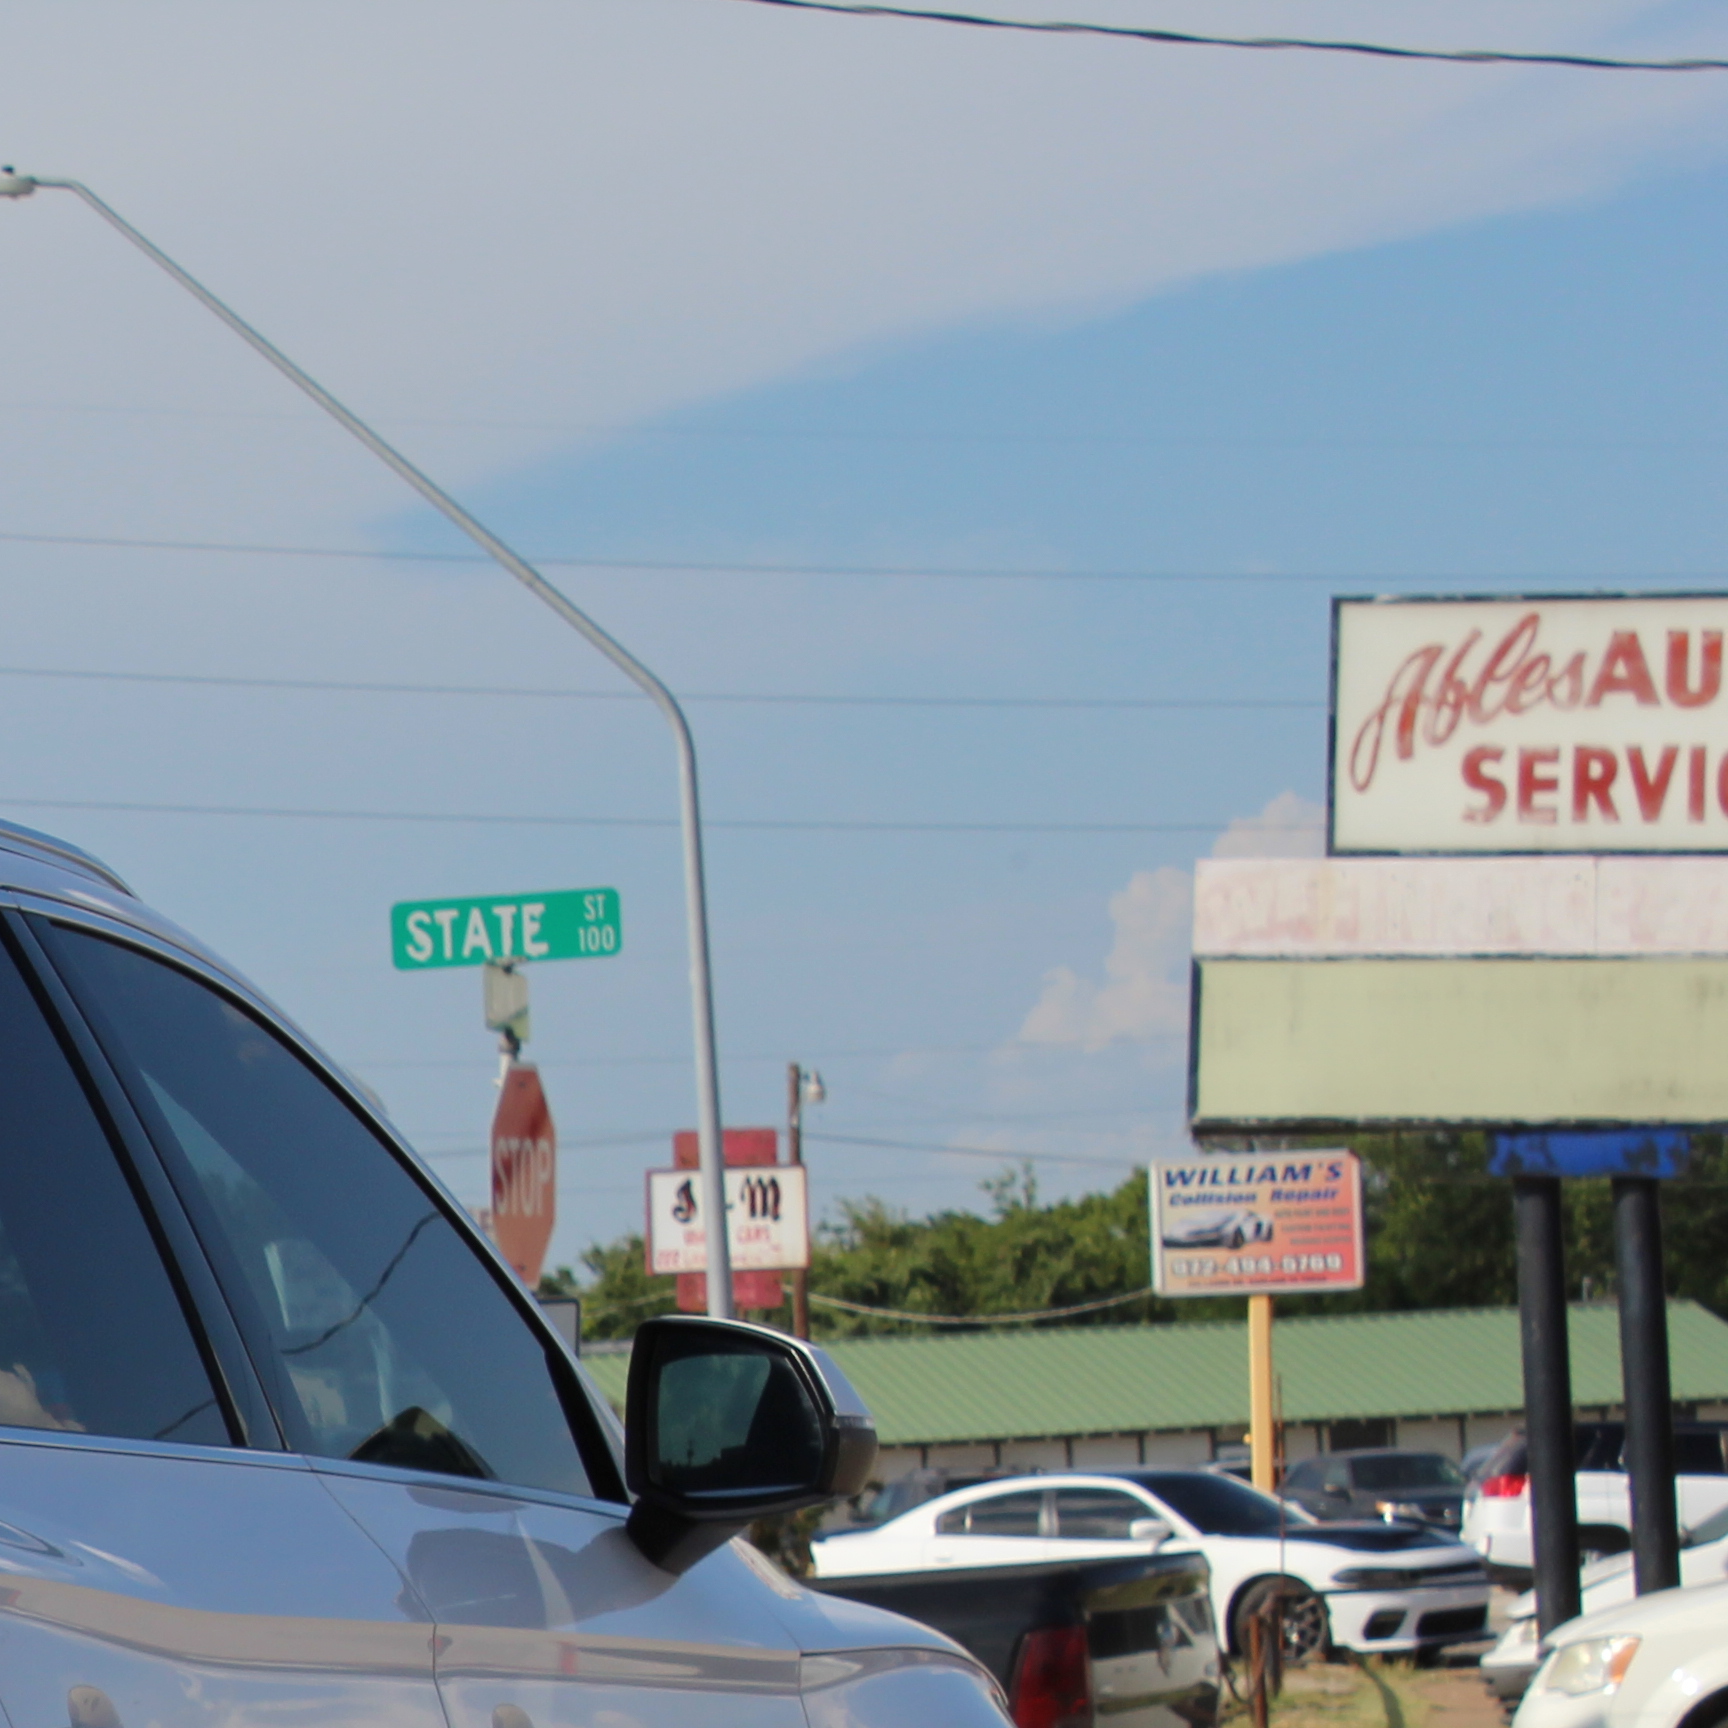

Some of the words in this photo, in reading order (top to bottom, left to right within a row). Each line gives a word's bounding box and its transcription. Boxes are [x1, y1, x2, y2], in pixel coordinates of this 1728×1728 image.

[1584, 629, 1725, 709] AU
[1461, 744, 1728, 824] SERVI
[405, 903, 550, 963] STATE
[584, 894, 606, 921] ST
[579, 925, 615, 952] 100
[495, 1136, 552, 1216] STOP
[1165, 1162, 1344, 1188] WILLIAM'S
